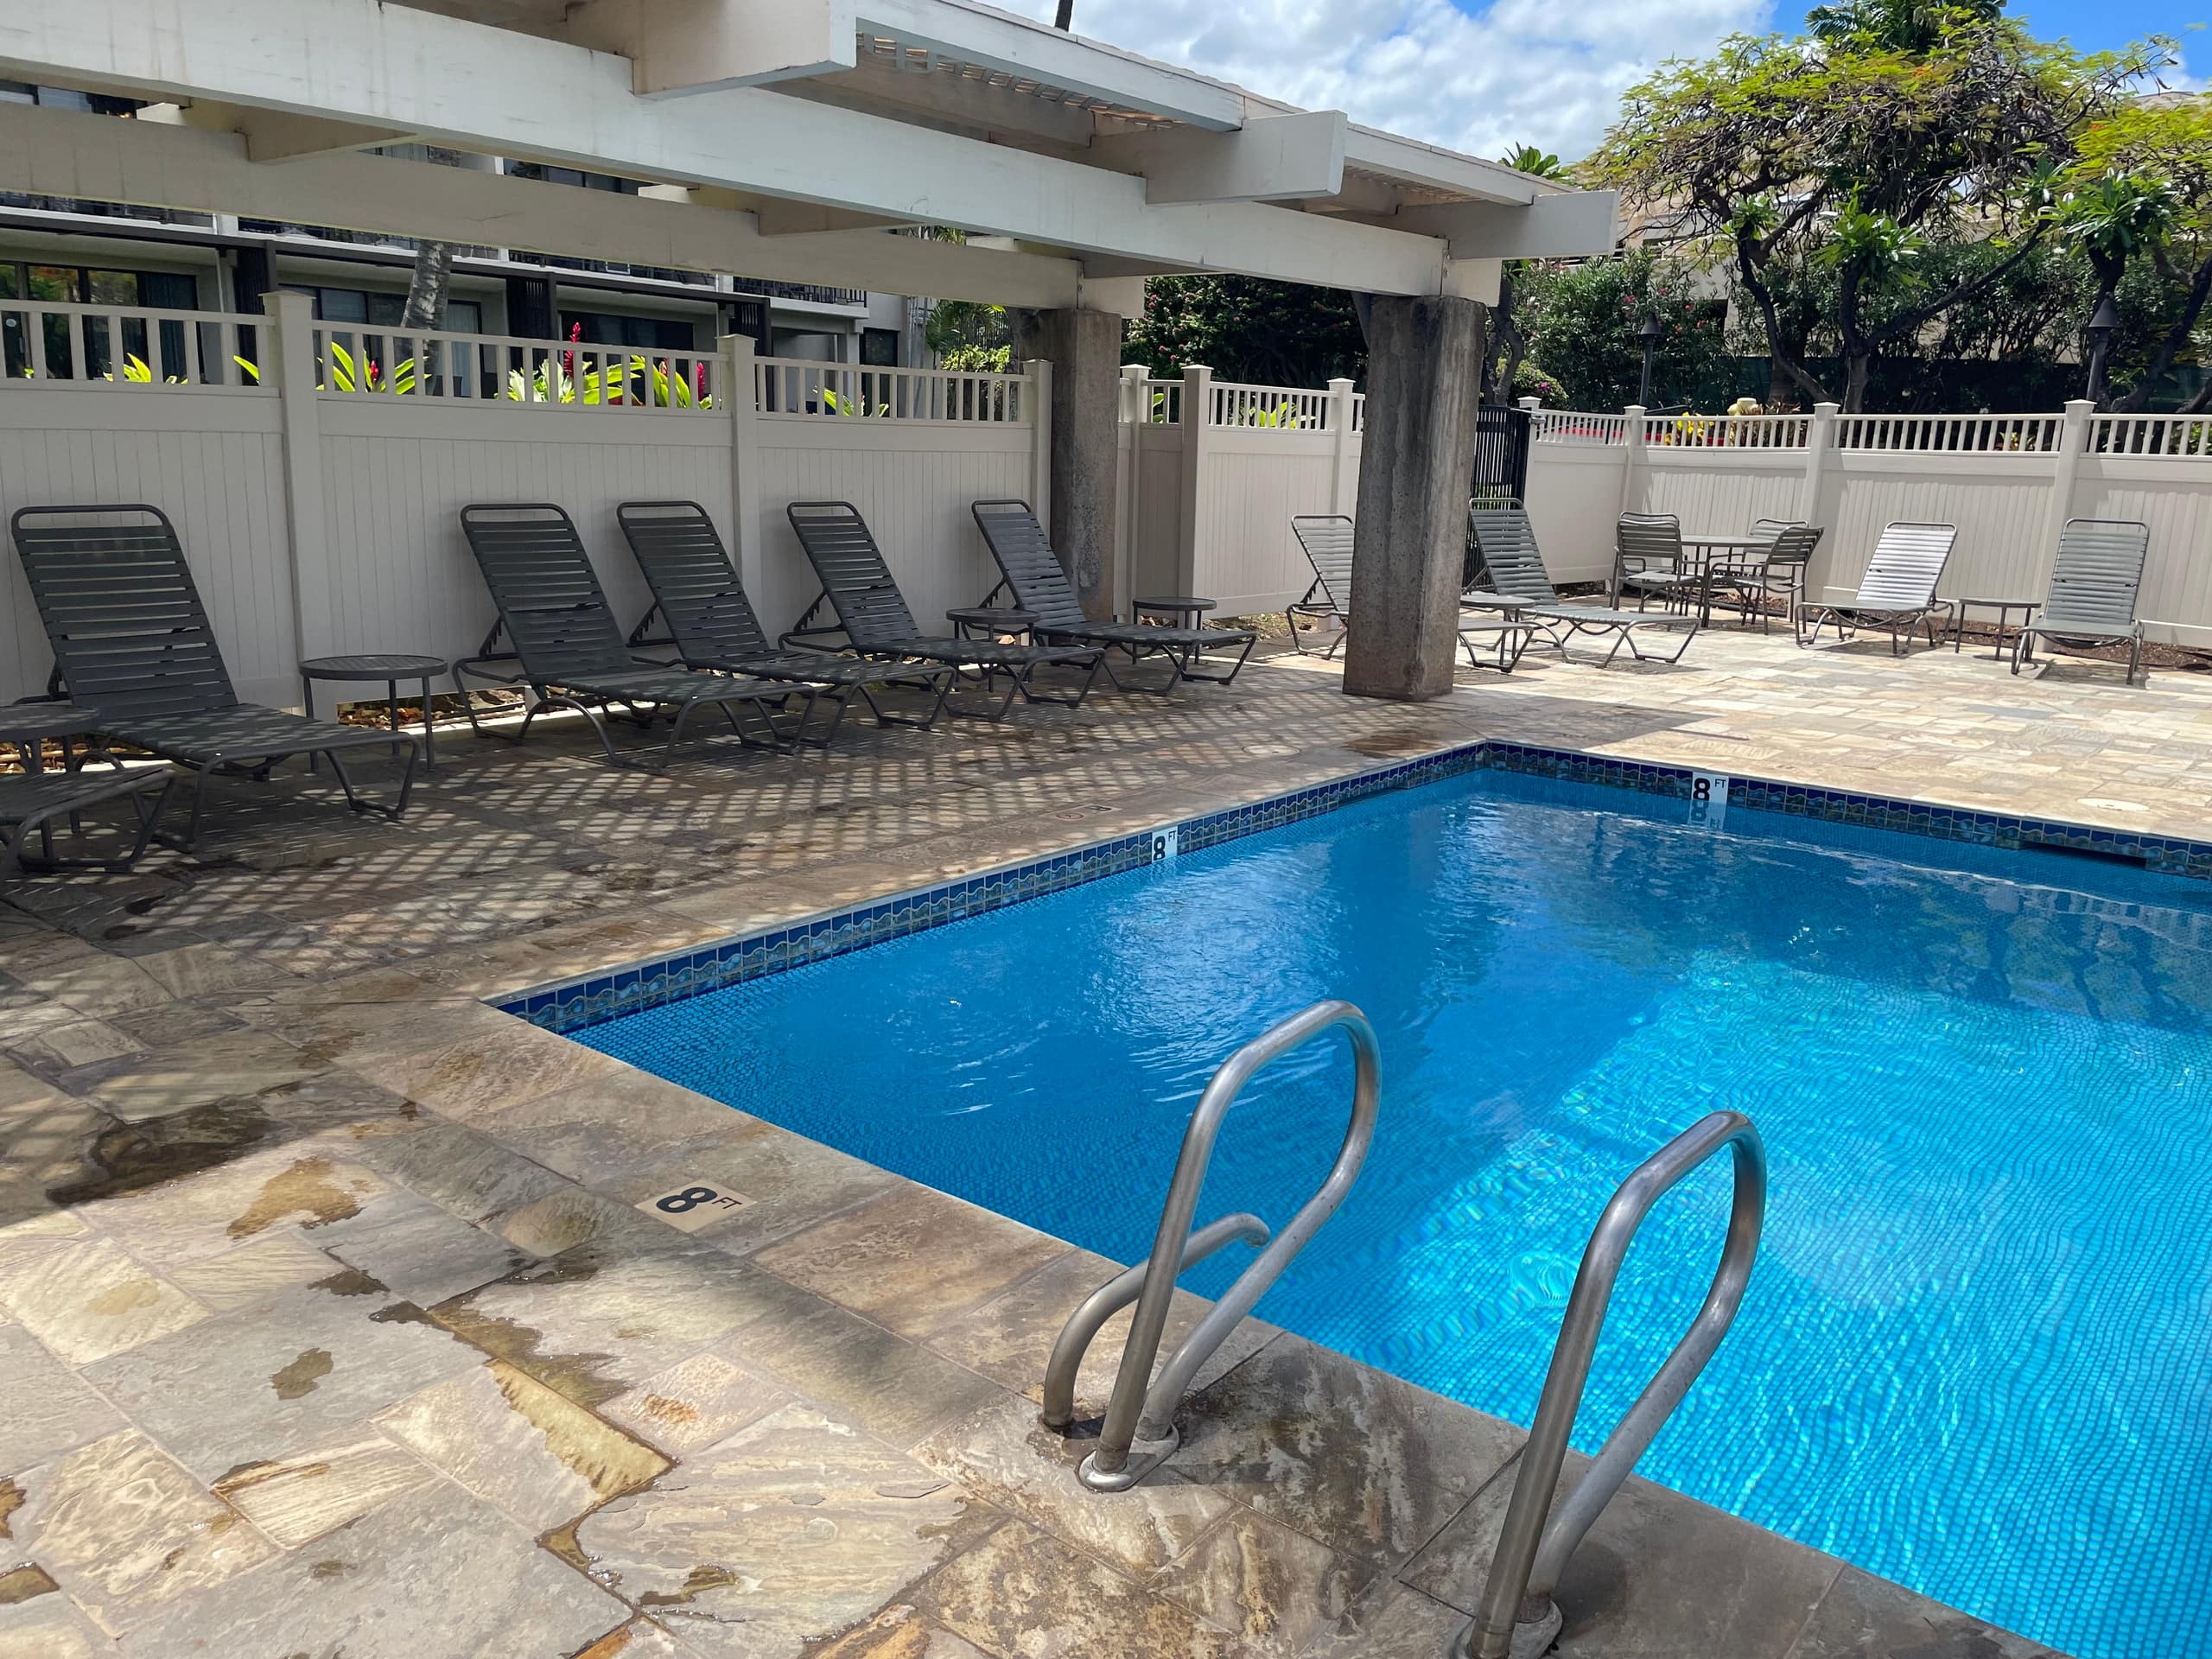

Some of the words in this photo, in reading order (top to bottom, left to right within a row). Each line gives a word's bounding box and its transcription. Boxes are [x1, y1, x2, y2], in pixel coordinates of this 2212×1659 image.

[1693, 778, 1710, 801] 8
[1714, 779, 1726, 788] FT
[1154, 836, 1166, 861] 8
[1168, 830, 1177, 842] FT
[656, 1186, 718, 1213] 8
[711, 1197, 742, 1209] FT
